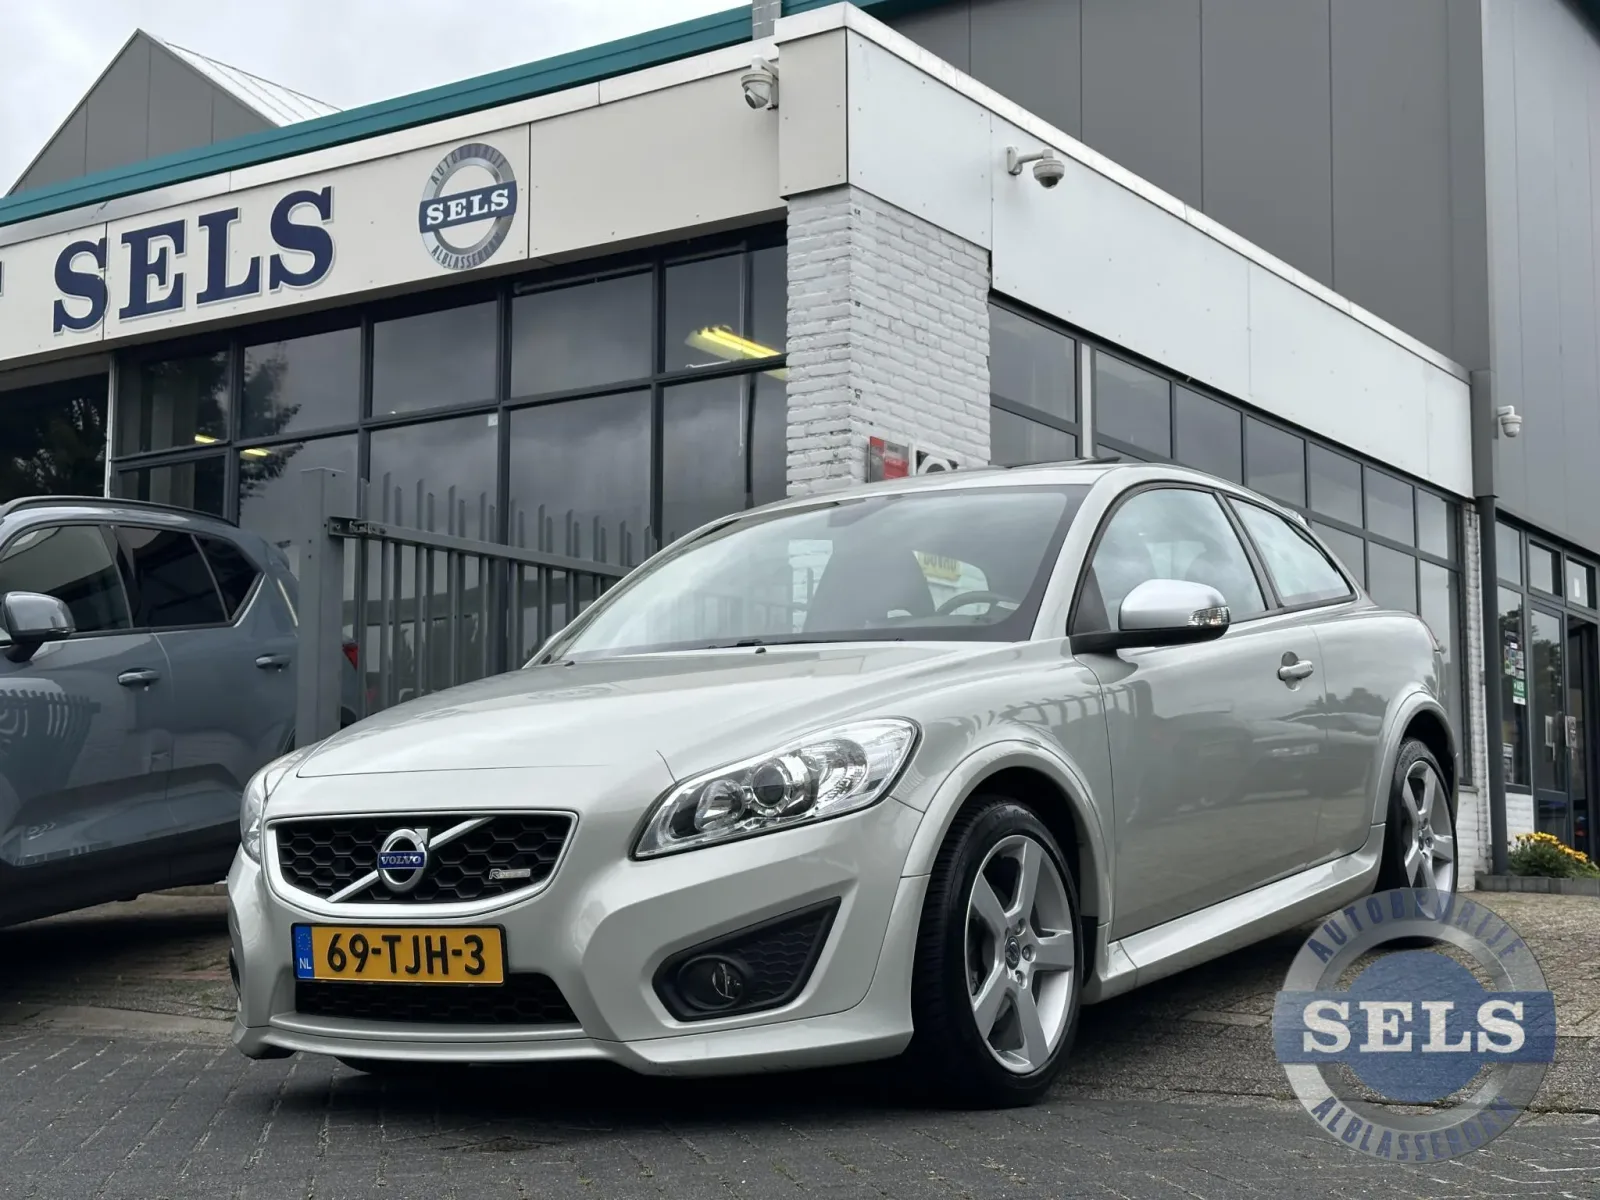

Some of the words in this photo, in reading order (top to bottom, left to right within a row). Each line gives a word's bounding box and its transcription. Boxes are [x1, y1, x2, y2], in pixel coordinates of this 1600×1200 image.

[431, 144, 507, 185] AUTOIJF
[426, 188, 509, 225] SELS
[53, 186, 334, 333] SELS
[380, 855, 422, 866] VOLVO
[299, 957, 312, 970] NL
[327, 933, 486, 975] 69-TJH-3
